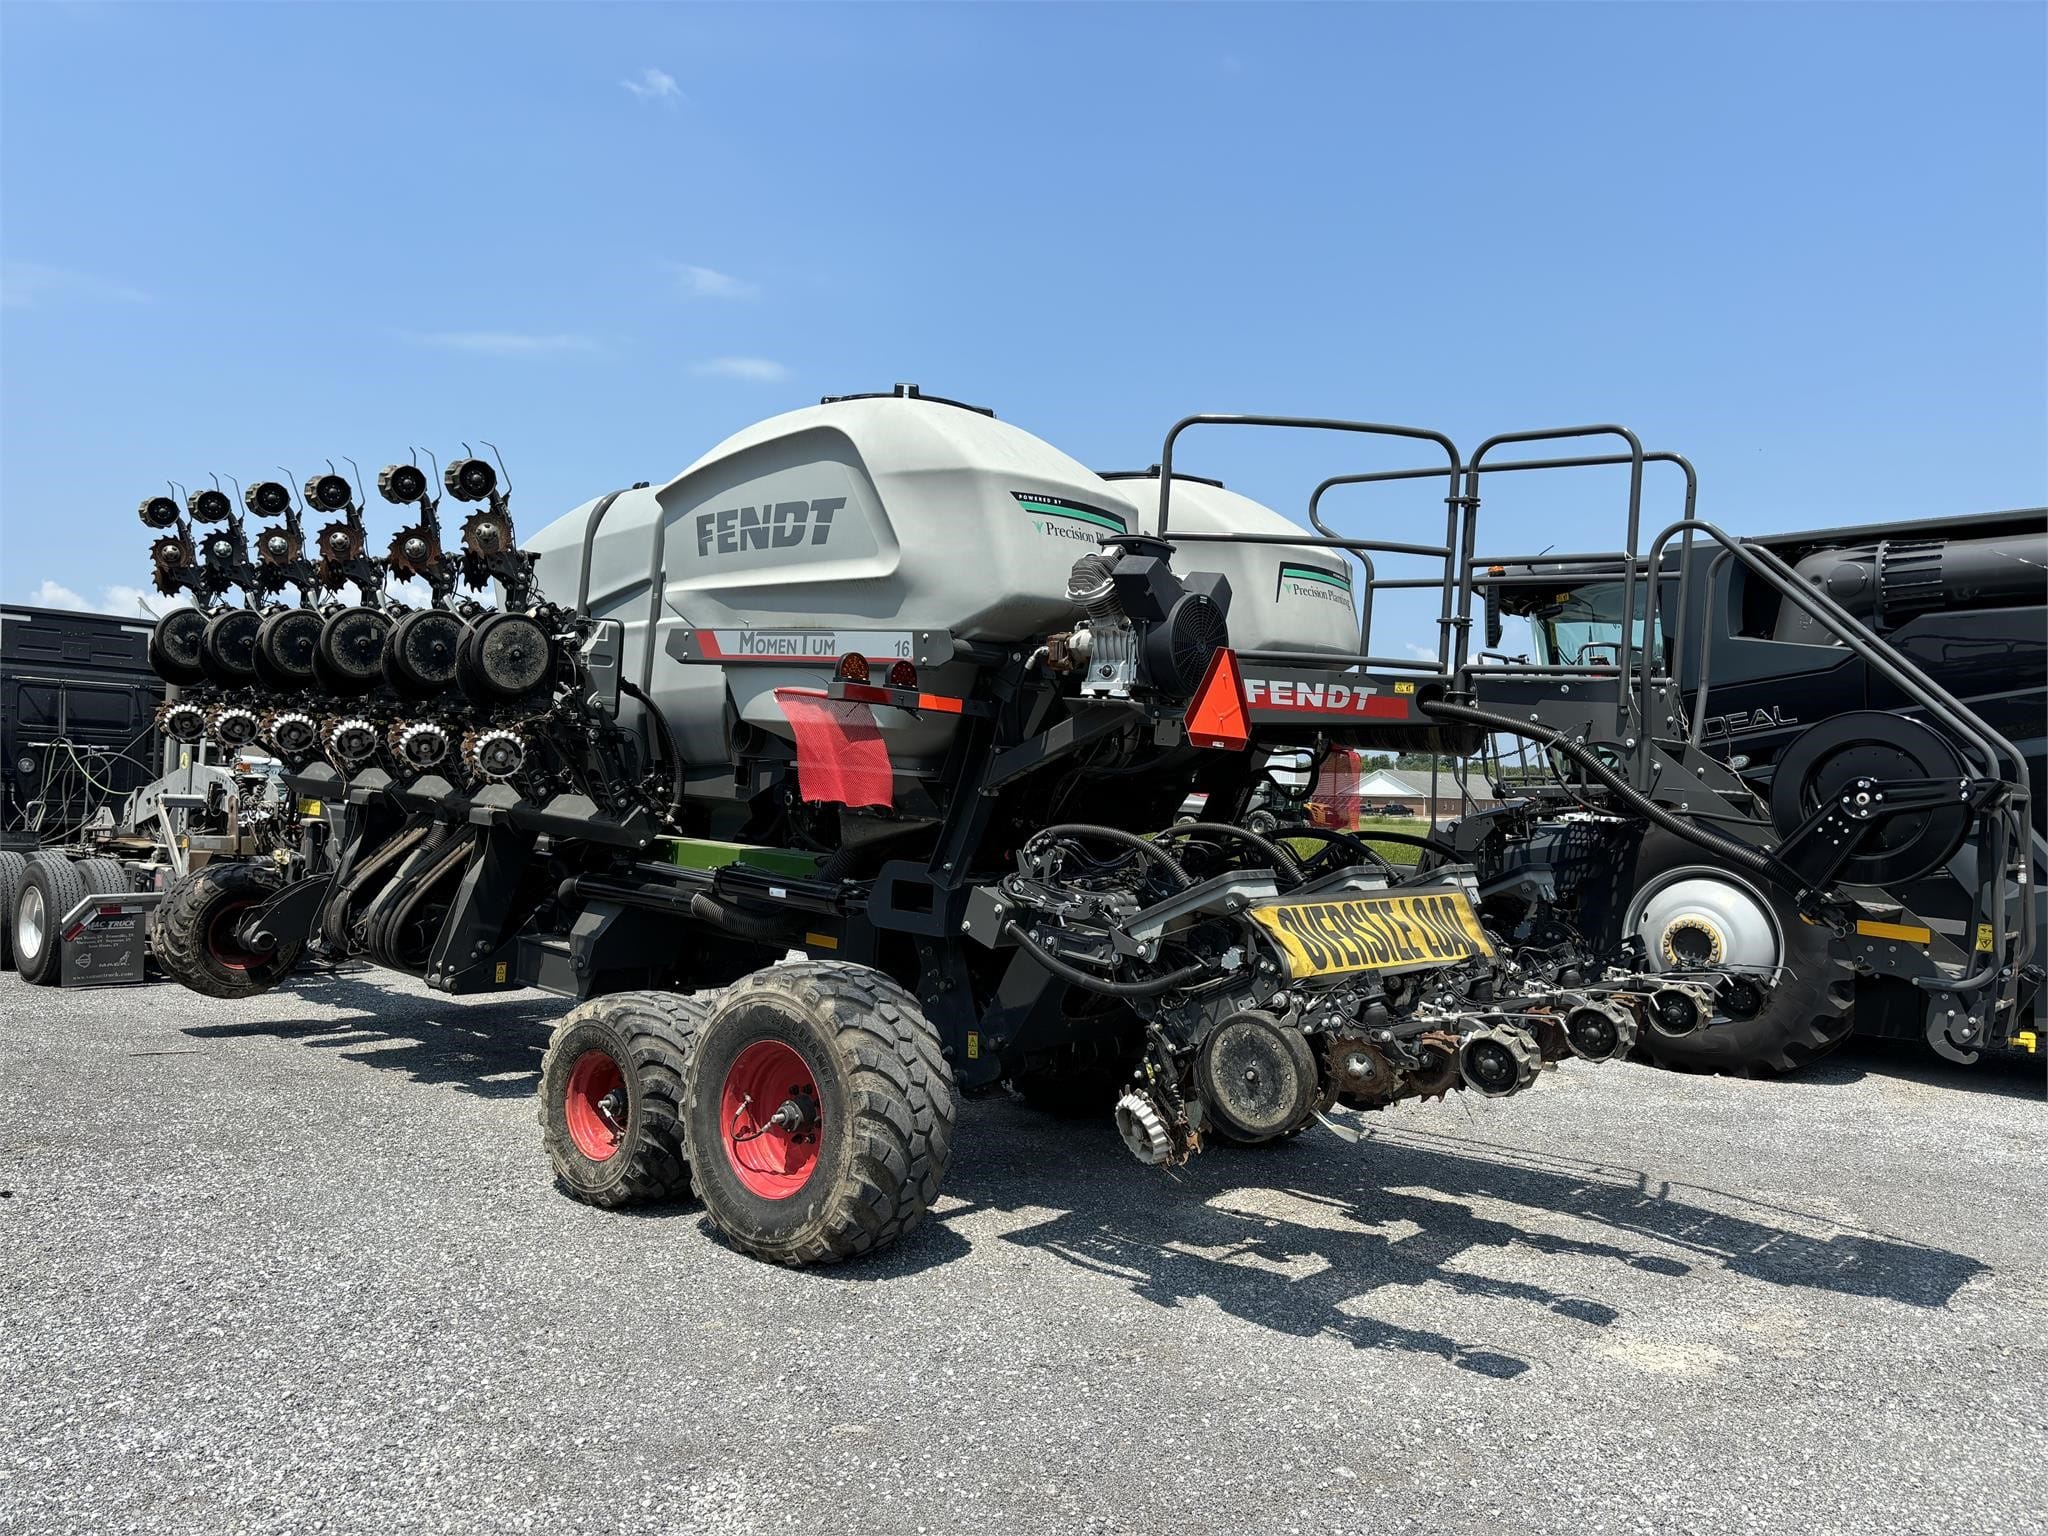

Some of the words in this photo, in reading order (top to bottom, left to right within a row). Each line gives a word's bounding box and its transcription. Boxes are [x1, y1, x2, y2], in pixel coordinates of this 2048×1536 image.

[1018, 494, 1051, 504] POWERED
[696, 496, 847, 557] FENDT
[1045, 522, 1095, 544] Precision
[1293, 584, 1328, 600] Precision
[1328, 590, 1351, 611] Planting
[894, 640, 910, 657] 16
[1243, 679, 1378, 711] FENDT
[1702, 705, 1798, 739] DEAL
[107, 920, 136, 929] TRUCK
[1277, 901, 1425, 970] OVERSIZE
[1399, 896, 1480, 959] LOAD
